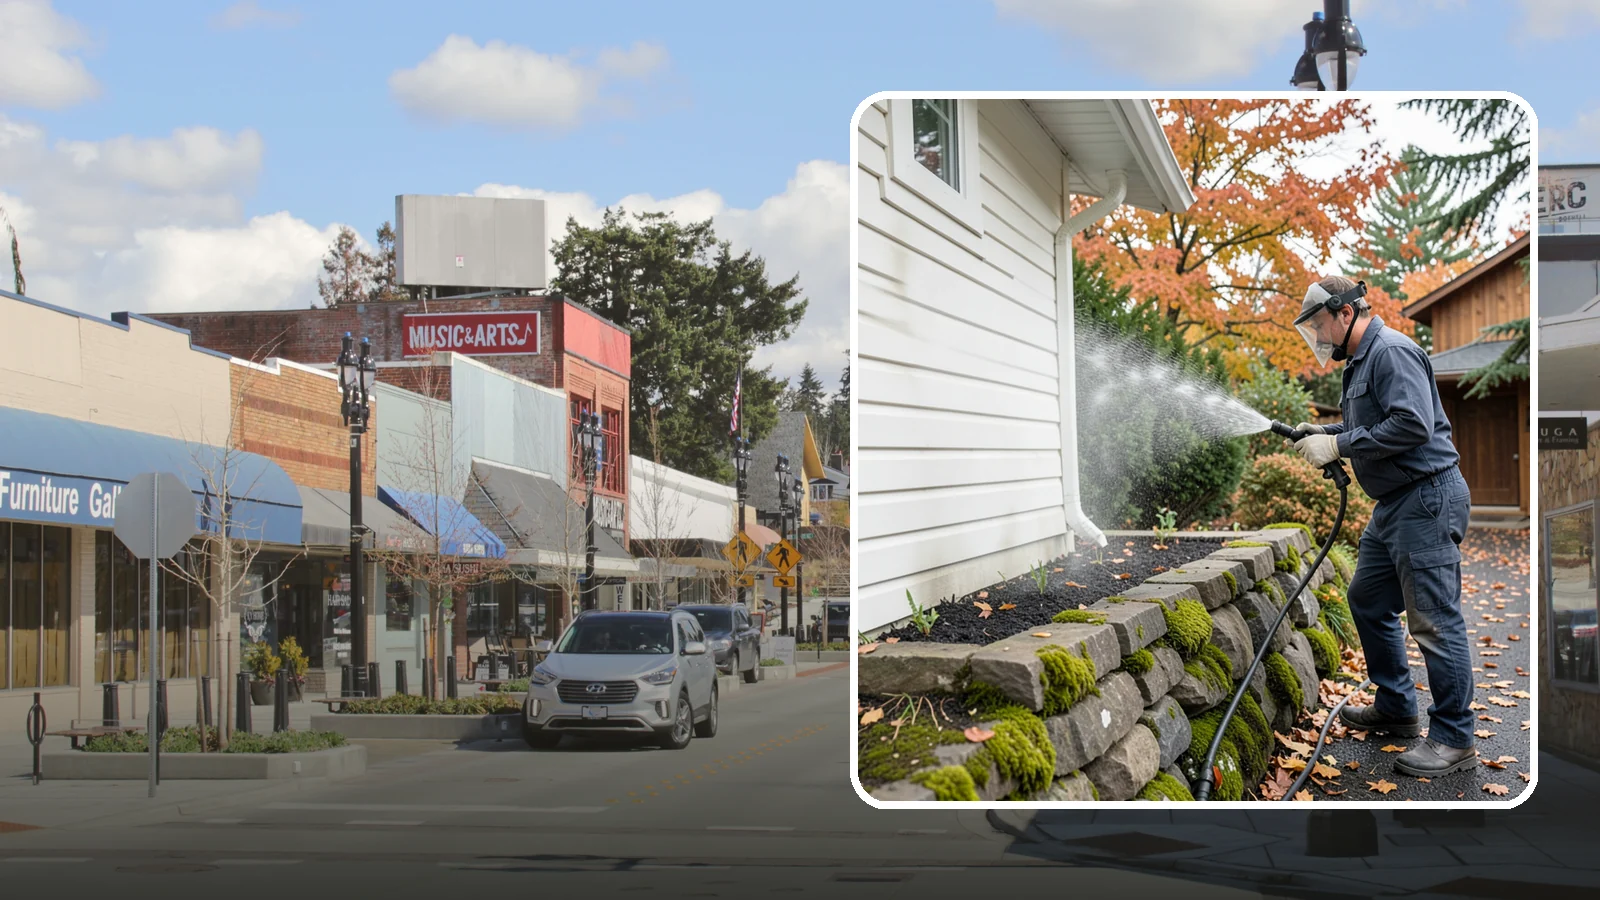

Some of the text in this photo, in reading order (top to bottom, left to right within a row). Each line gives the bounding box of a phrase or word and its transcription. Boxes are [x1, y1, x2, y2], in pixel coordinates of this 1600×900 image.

[0, 471, 122, 519] Furniture Gal
[453, 562, 480, 574] SUSHI
